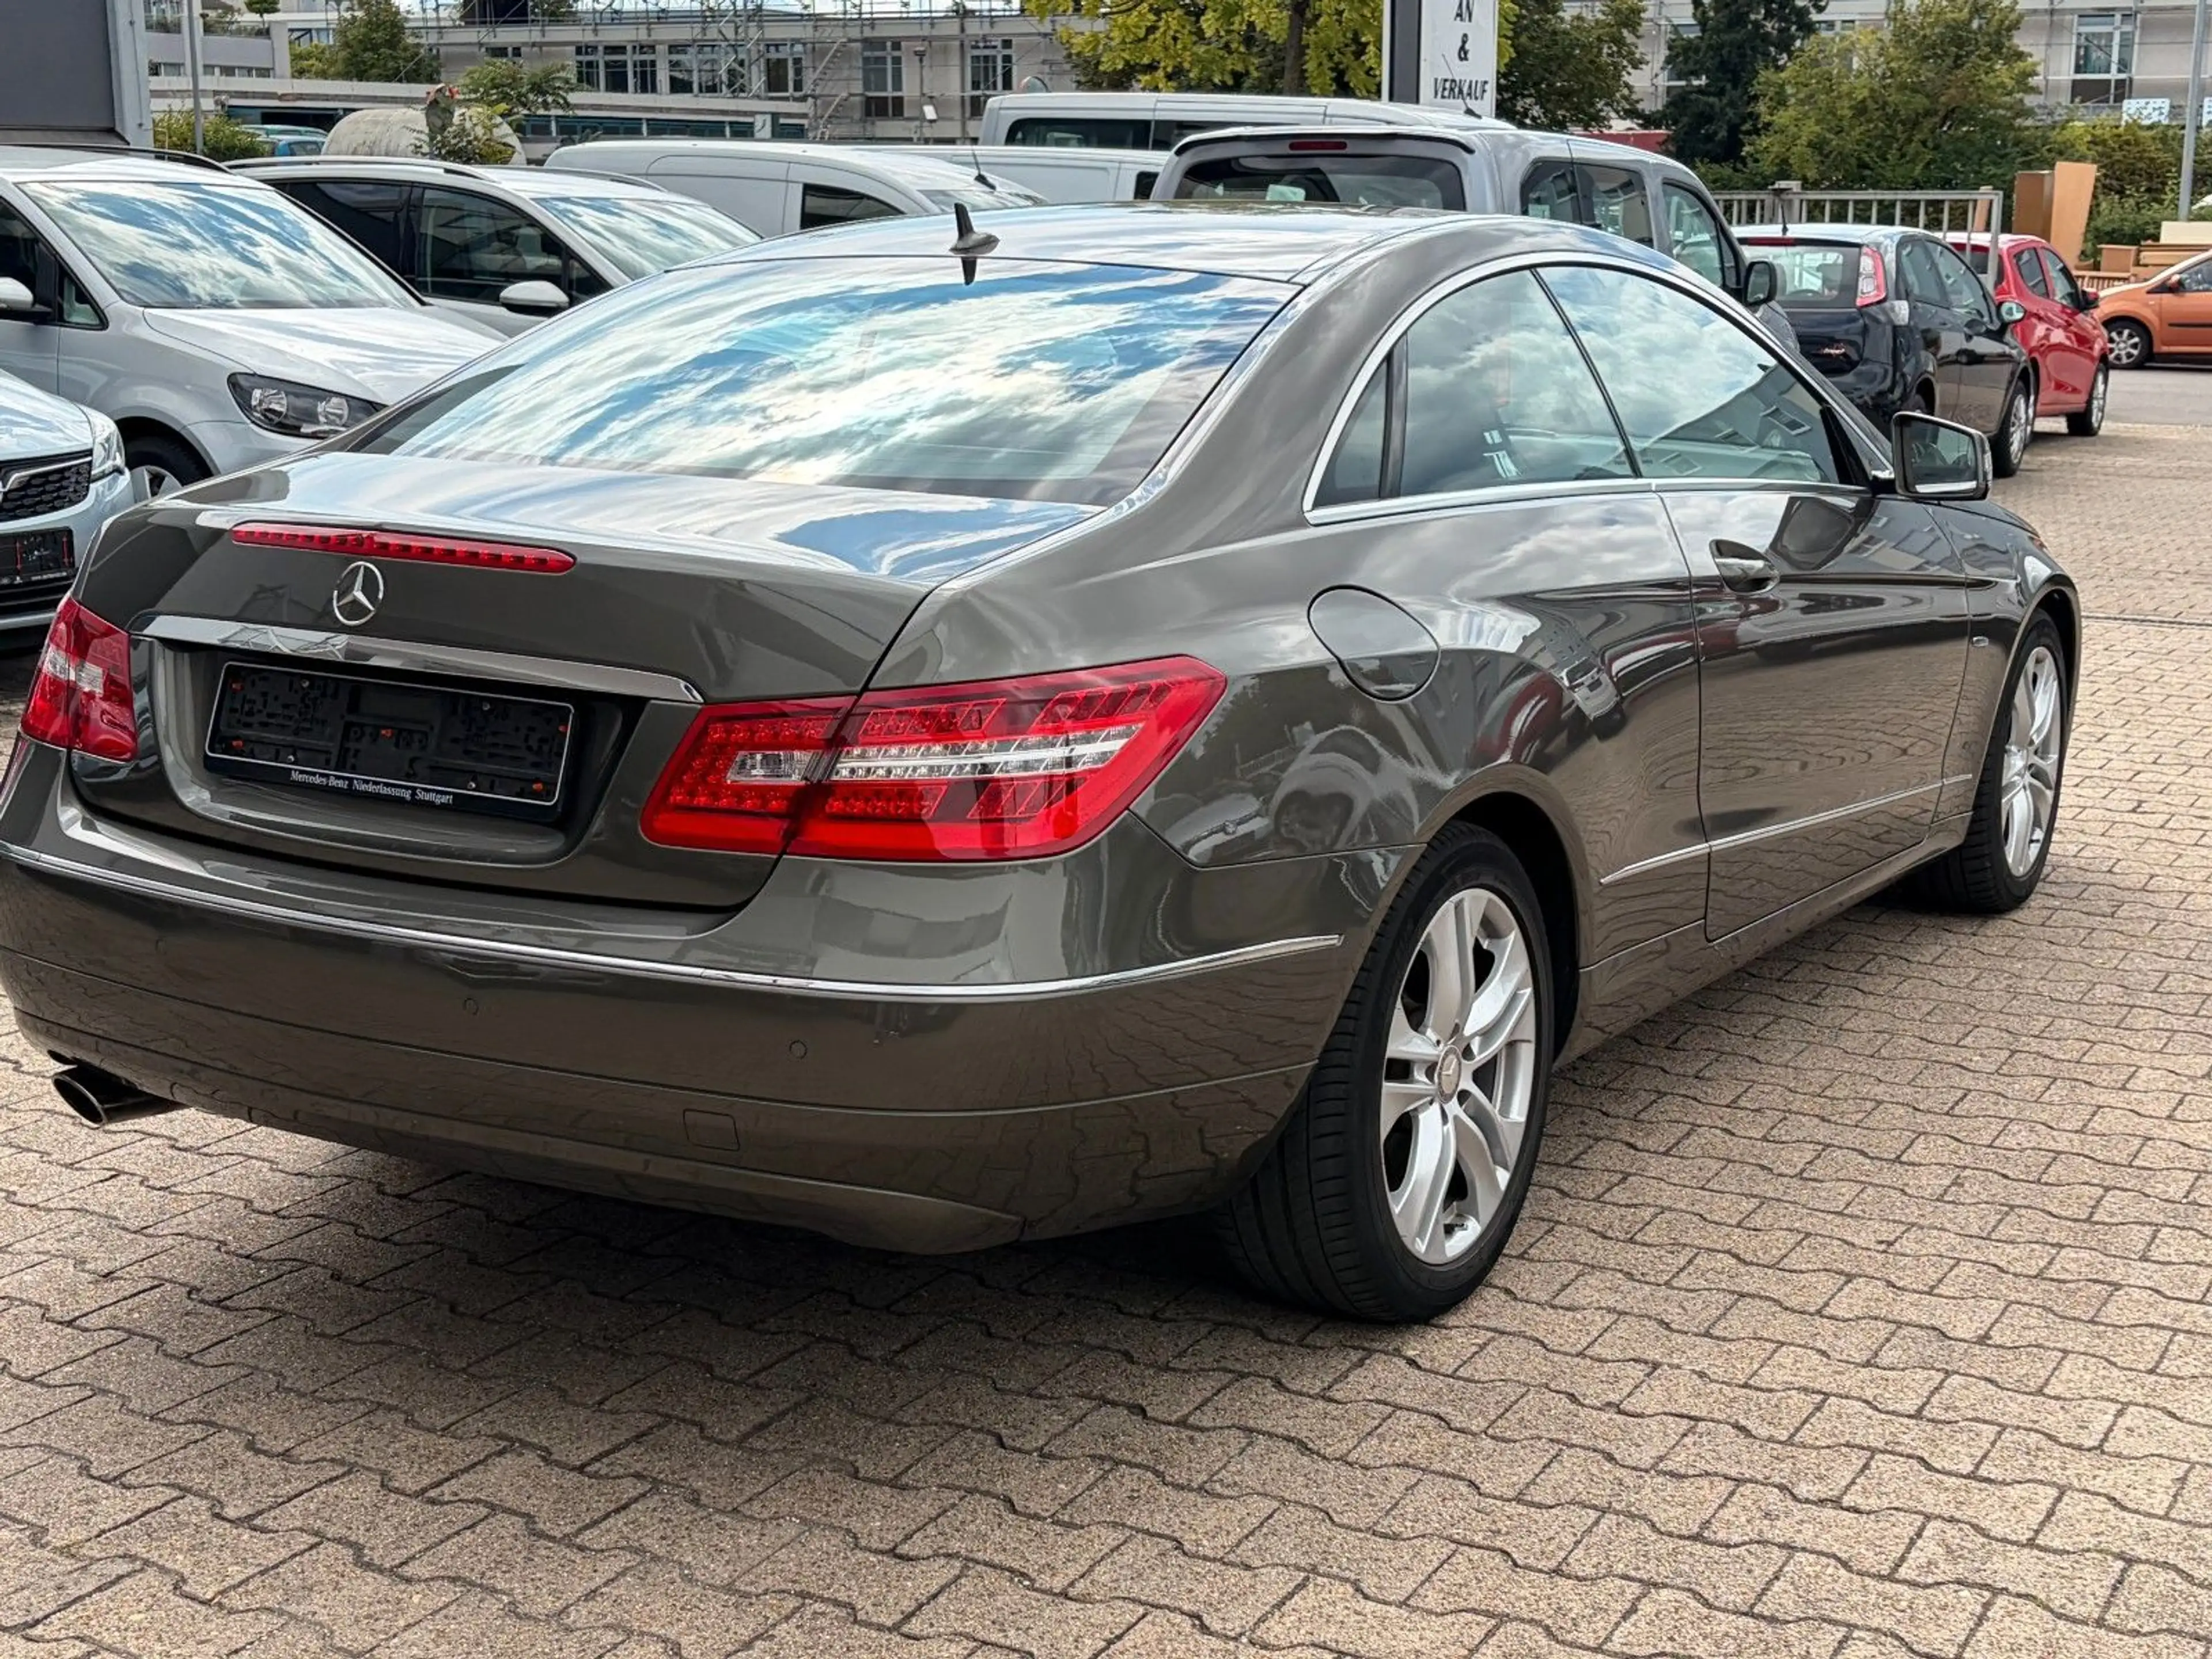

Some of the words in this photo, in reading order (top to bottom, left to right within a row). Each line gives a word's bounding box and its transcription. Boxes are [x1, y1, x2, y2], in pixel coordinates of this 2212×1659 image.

[1454, 0, 1475, 22] AN
[1457, 33, 1470, 62] &
[1433, 77, 1489, 101] VERKAUF
[290, 770, 349, 789] Mercedes-Benz
[352, 779, 412, 800] Niederlassung
[414, 788, 453, 805] Stuttgart
